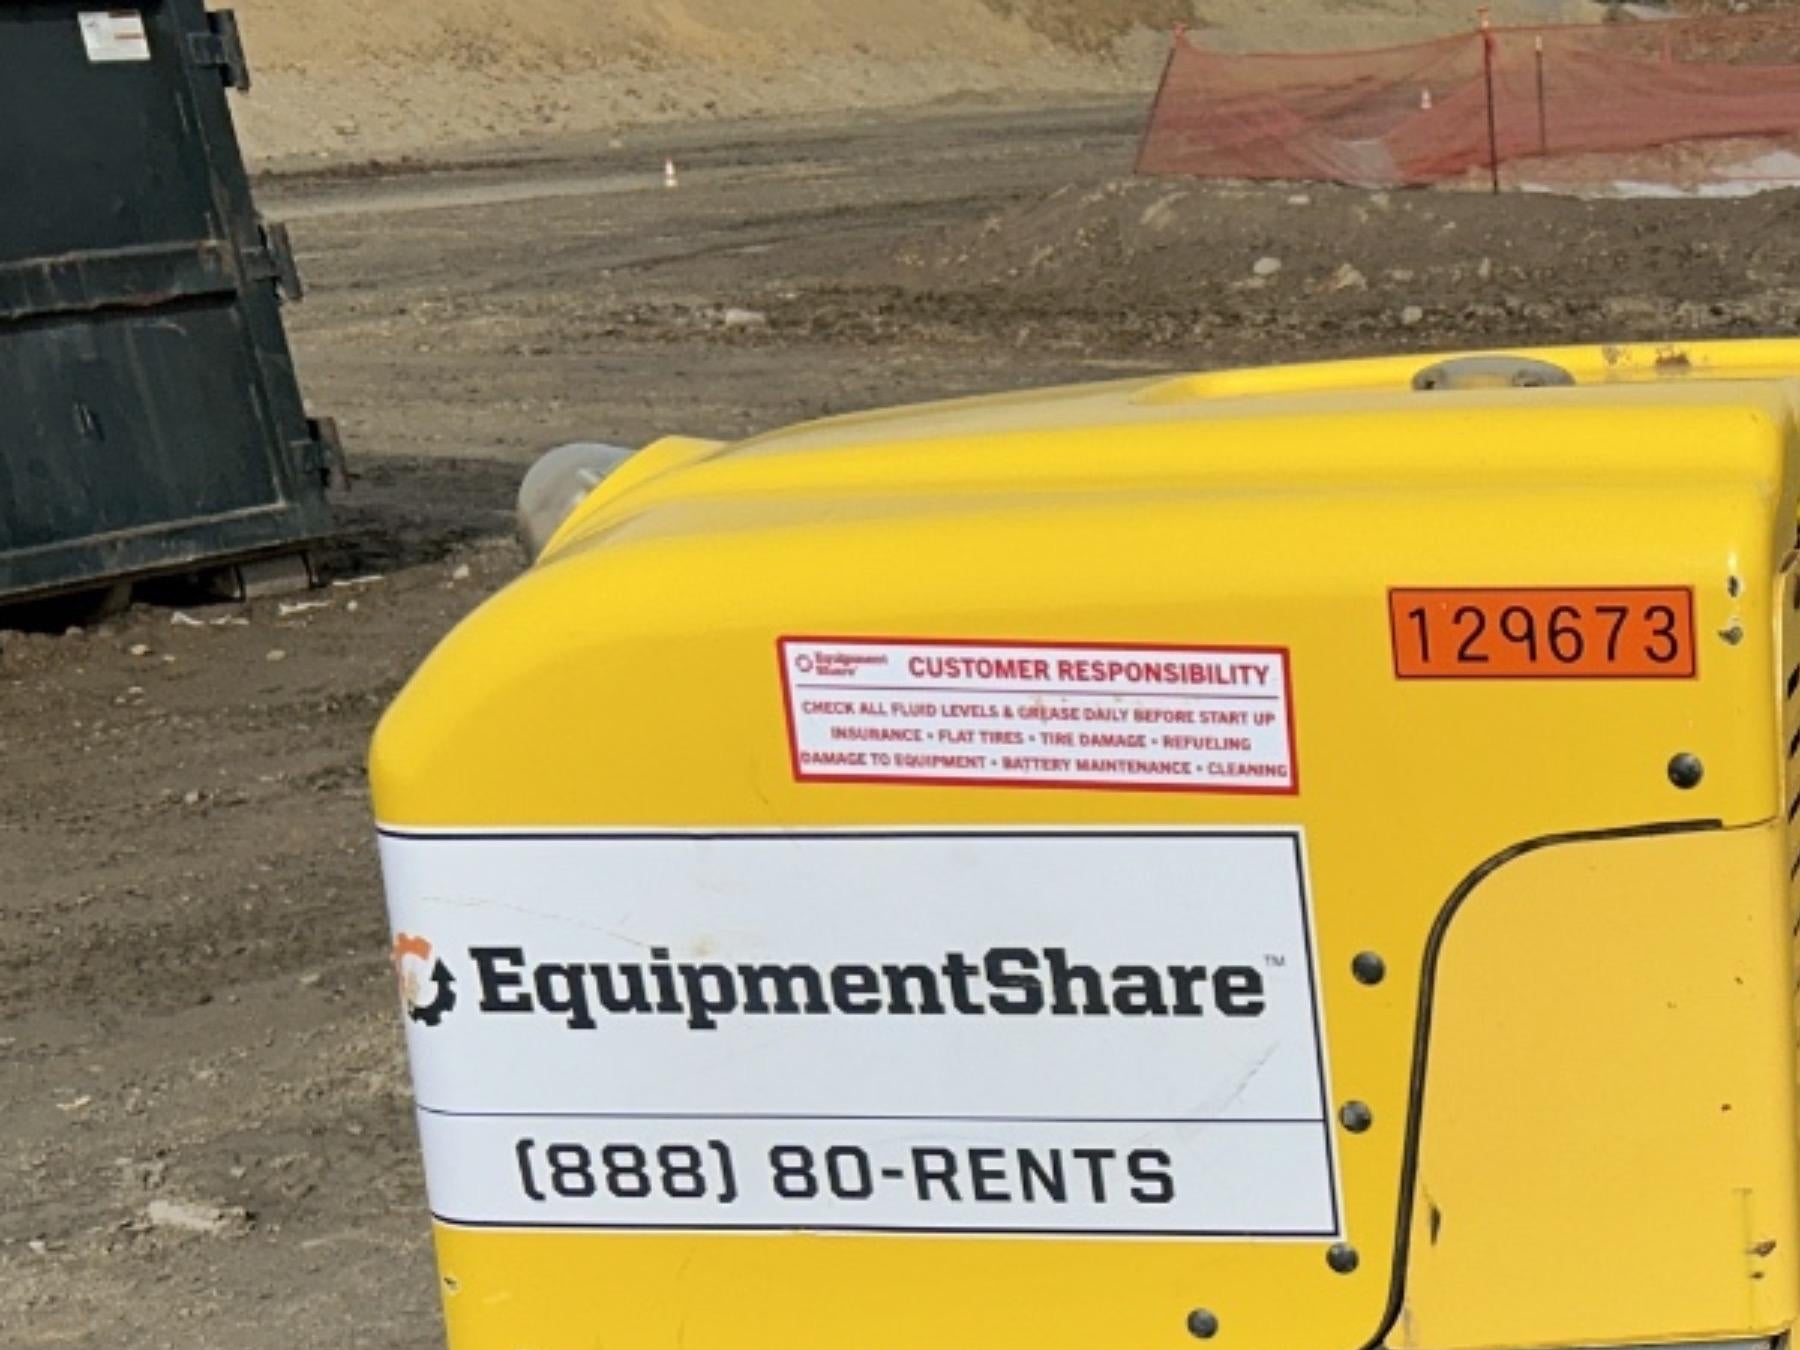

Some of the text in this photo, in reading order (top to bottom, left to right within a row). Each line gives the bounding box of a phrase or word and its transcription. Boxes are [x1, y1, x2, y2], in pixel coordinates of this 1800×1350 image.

[1407, 604, 1680, 664] 129673
[908, 656, 1270, 686] CUSTOMER RESPONSIBILITY
[801, 701, 858, 715] CHECK
[860, 702, 888, 716] ALL
[891, 703, 937, 718] FLUID
[941, 704, 999, 718] LEVELS
[1017, 705, 1080, 721] GREASE
[1084, 707, 1129, 721] DAILY
[1133, 708, 1195, 723] BEFORE
[1199, 710, 1249, 725] START
[1253, 711, 1276, 726] UP
[830, 726, 1252, 751] INSURANCE FLAT TIRES TIRE DAMAGE REFUELING
[800, 752, 1288, 778] DAMAGE TO EQUIPMENT BATTERY MAINTENANCE CLEANING
[467, 946, 1266, 1030] EquipmentShare
[515, 1138, 1177, 1205] (888) 80-RENTS
